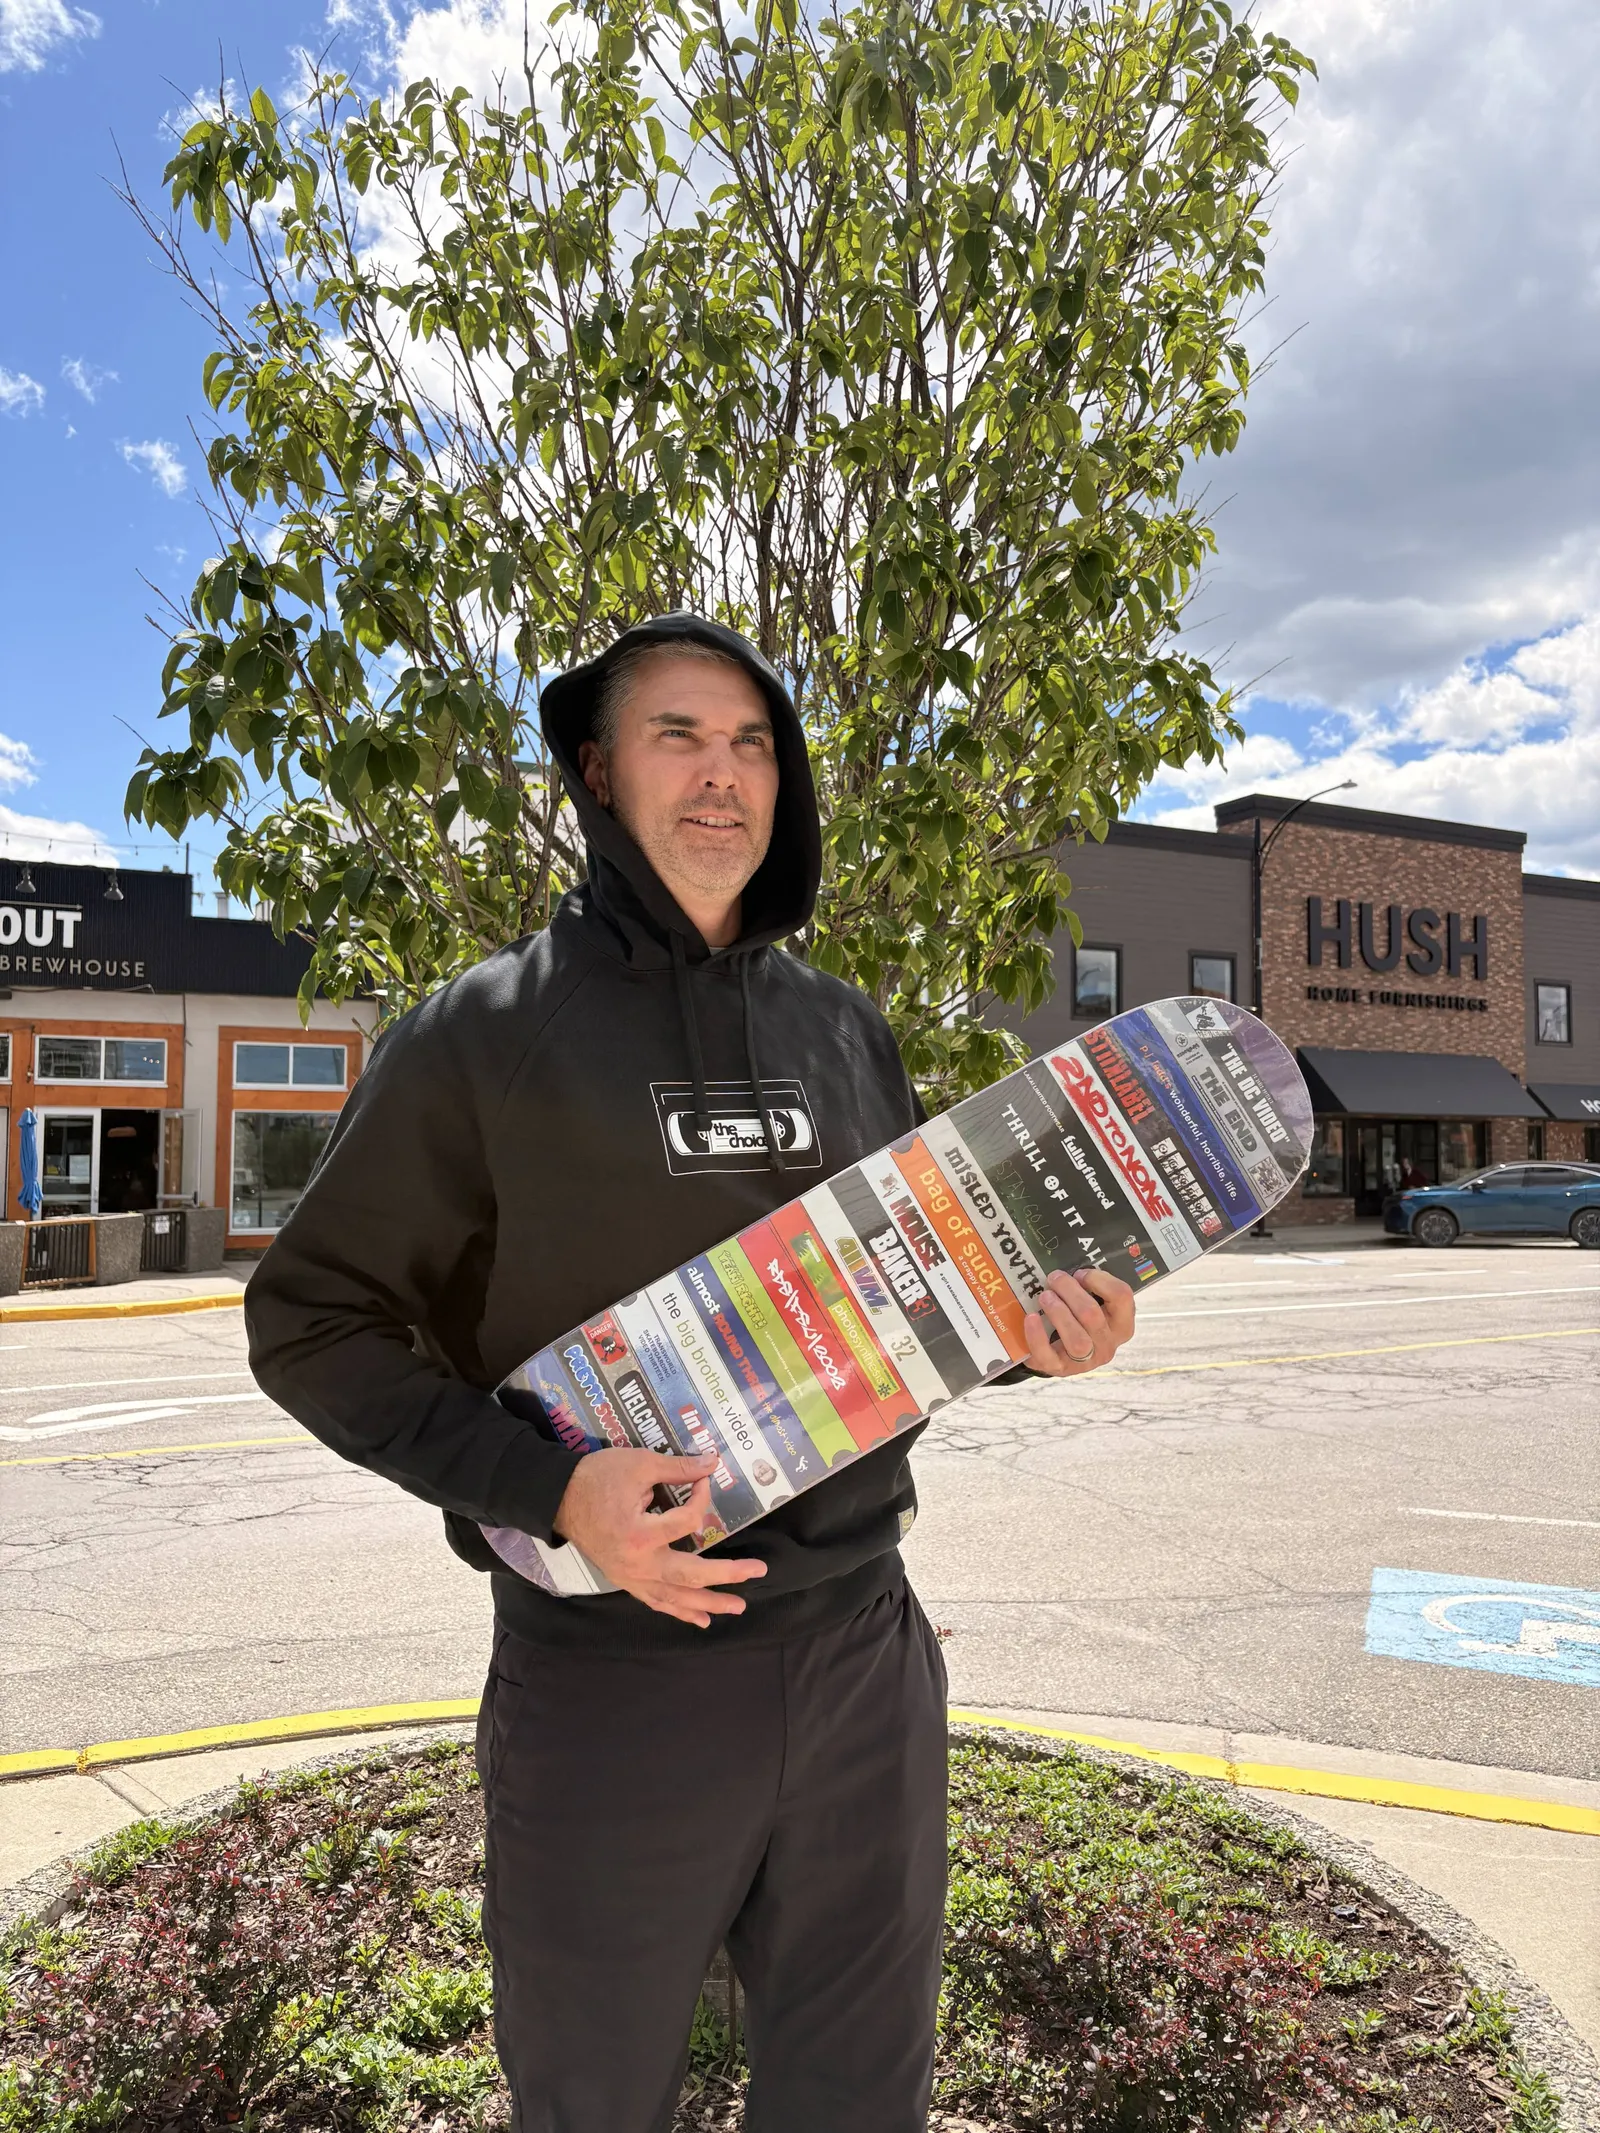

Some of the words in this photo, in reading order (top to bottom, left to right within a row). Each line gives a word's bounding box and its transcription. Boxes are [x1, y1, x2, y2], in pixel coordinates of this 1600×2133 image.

[0, 906, 82, 949] OUT
[1307, 896, 1488, 980] HUSH
[0, 955, 145, 978] BREWHOUSE
[1307, 986, 1361, 1004] HOME
[1369, 990, 1488, 1012] FURNISHINGS
[1022, 1069, 1035, 1086] LAKAI
[1032, 1084, 1048, 1105] LIMITED
[1044, 1103, 1065, 1134] FOOTWEAR
[1197, 1065, 1230, 1107] THE
[1223, 1107, 1260, 1154] END
[1236, 1075, 1261, 1101] DC
[713, 1122, 737, 1137] the
[1167, 1088, 1204, 1141] wonderful,
[1197, 1139, 1229, 1182] horrible,
[1222, 1180, 1241, 1202] life.
[998, 1101, 1049, 1173] THRILL
[1040, 1172, 1069, 1204] OF
[1060, 1204, 1085, 1231] IT
[1060, 1133, 1115, 1212] fullyflared
[888, 1194, 947, 1272] MOUSE
[914, 1166, 956, 1215] bag
[945, 1211, 974, 1242] of
[960, 1238, 1007, 1298] suck
[659, 1291, 686, 1320] the
[684, 1263, 723, 1316] almost
[710, 1312, 746, 1360] ROUND
[714, 1248, 745, 1287] YEAH
[731, 1281, 769, 1331] RIGHT!
[959, 1260, 978, 1285] crappy
[975, 1284, 991, 1305] video
[985, 1303, 997, 1315] by
[588, 1321, 614, 1339] DANGER!
[639, 1328, 674, 1379] SKATEBOARDING
[650, 1333, 680, 1375] TRANSWORLD
[671, 1318, 700, 1349] big
[831, 1302, 888, 1386] photosynthesis
[888, 1333, 918, 1363] 32
[636, 1334, 651, 1354] VIDEO
[645, 1352, 667, 1382] THIRTEEN
[613, 1378, 671, 1454] WELCOME
[679, 1407, 704, 1432] in
